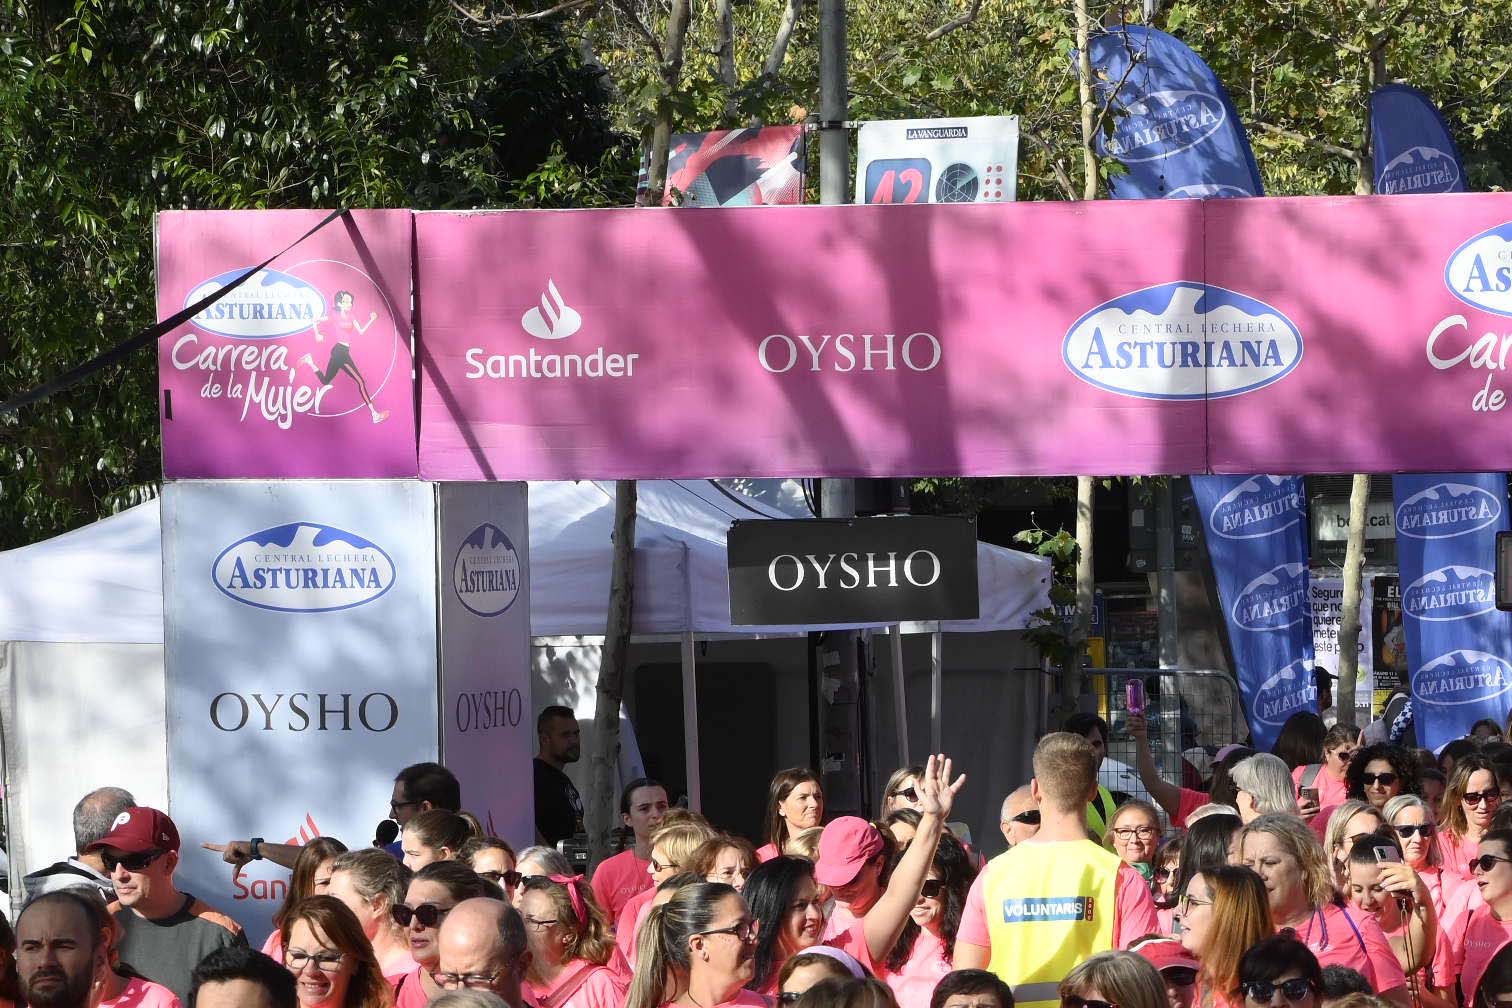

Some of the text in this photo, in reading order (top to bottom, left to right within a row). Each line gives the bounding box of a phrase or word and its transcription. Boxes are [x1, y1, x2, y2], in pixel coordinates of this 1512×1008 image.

[1118, 322, 1276, 335] CENTRAL LECHERA
[172, 333, 289, 371] Carrera
[465, 348, 639, 379] Santander
[758, 332, 942, 375] OYSHO
[1081, 326, 1284, 370] ASTURIANA
[200, 370, 333, 430] de la Mujer
[1471, 372, 1507, 412] de
[226, 556, 383, 589] ASTURIANA
[254, 554, 376, 563] CENTRAL LECHERA
[458, 558, 517, 594] ASTURIANA
[768, 549, 941, 592] OYSHO
[1312, 603, 1329, 613] que
[1314, 614, 1344, 626] quiere
[1314, 628, 1337, 639] mete
[209, 692, 400, 732] OYSHO
[456, 688, 522, 733] OYSHO
[1004, 901, 1083, 918] VOLUNTARIS
